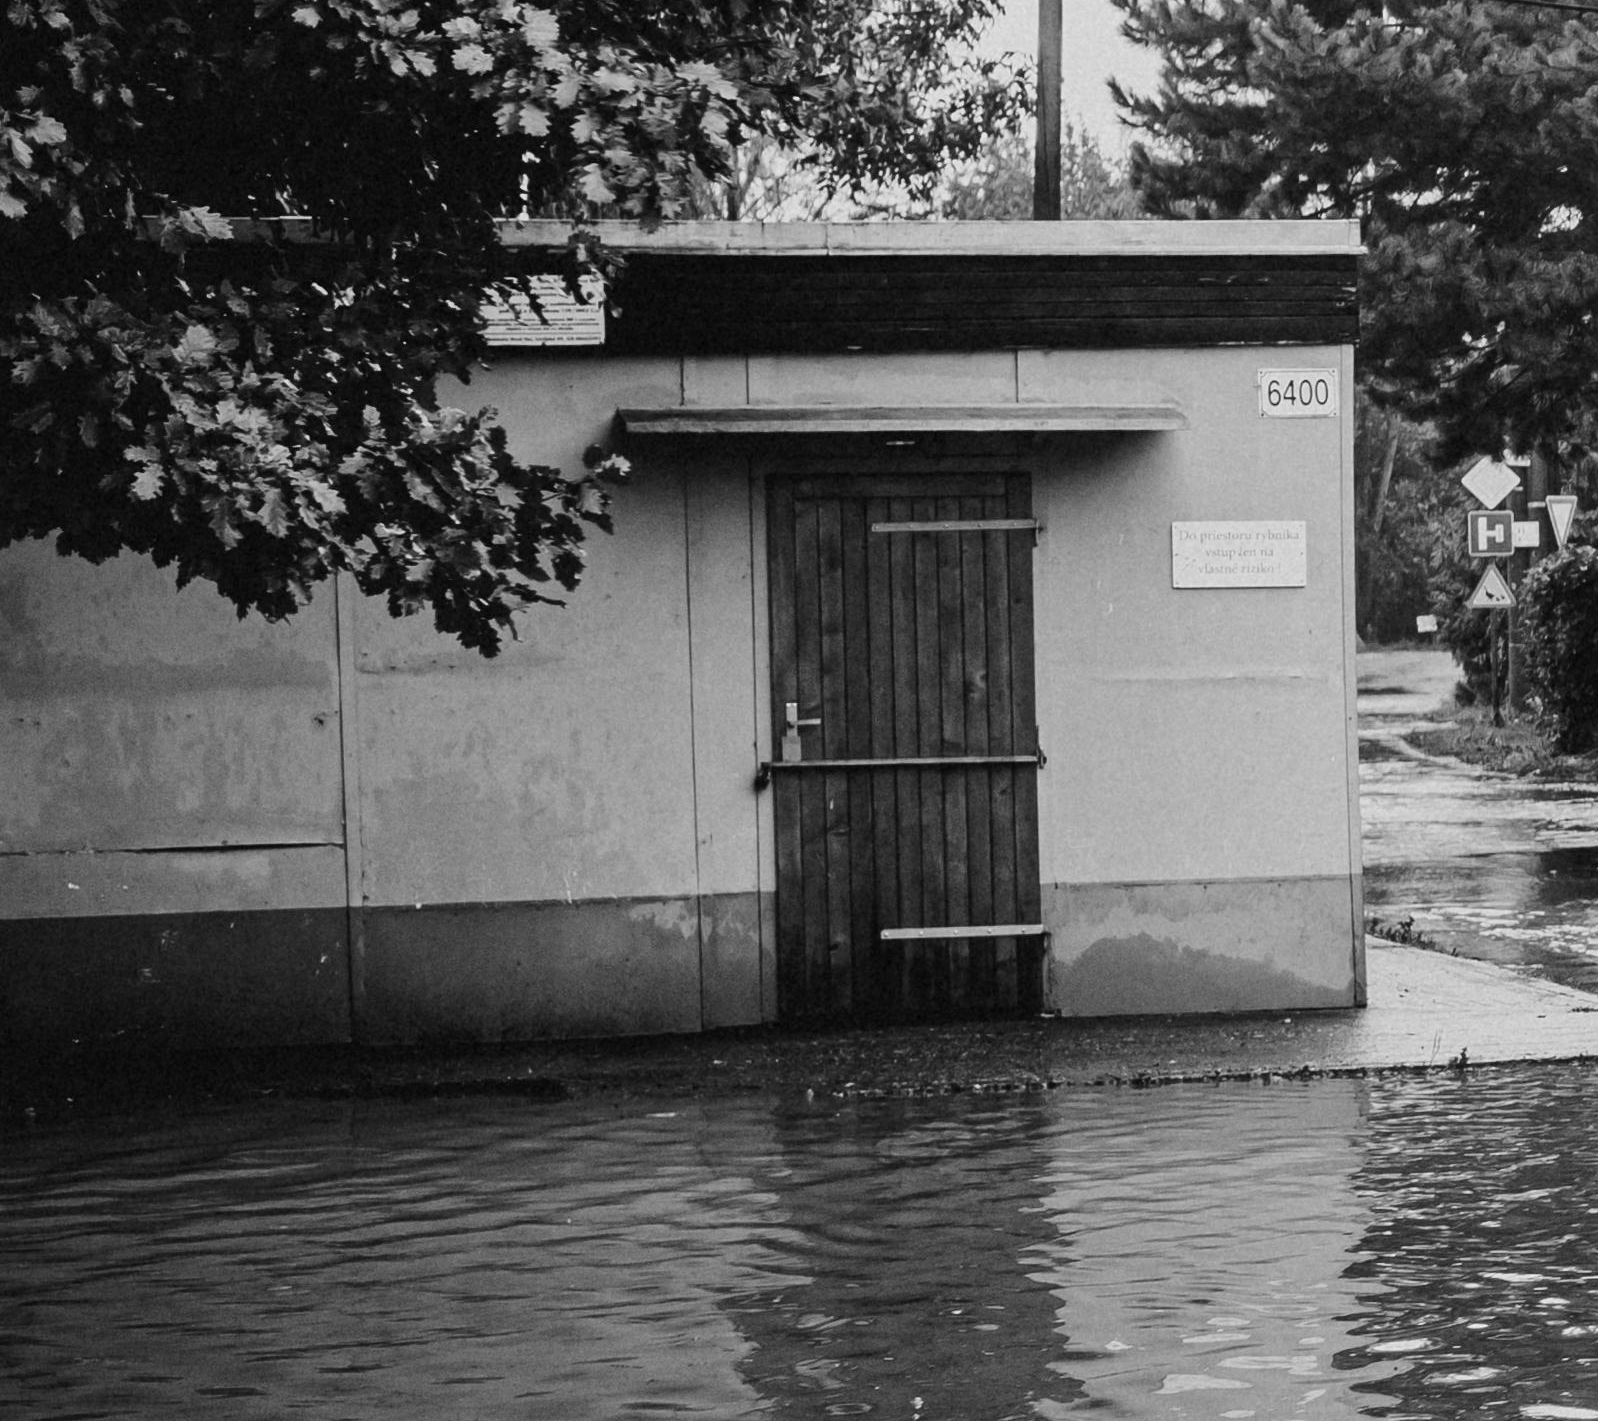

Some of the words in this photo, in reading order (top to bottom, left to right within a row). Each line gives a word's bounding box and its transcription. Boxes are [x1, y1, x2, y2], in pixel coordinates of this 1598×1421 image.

[1268, 379, 1328, 406] 6400
[1179, 531, 1197, 541] Do
[1205, 549, 1236, 560] vstup
[1260, 549, 1274, 557] na
